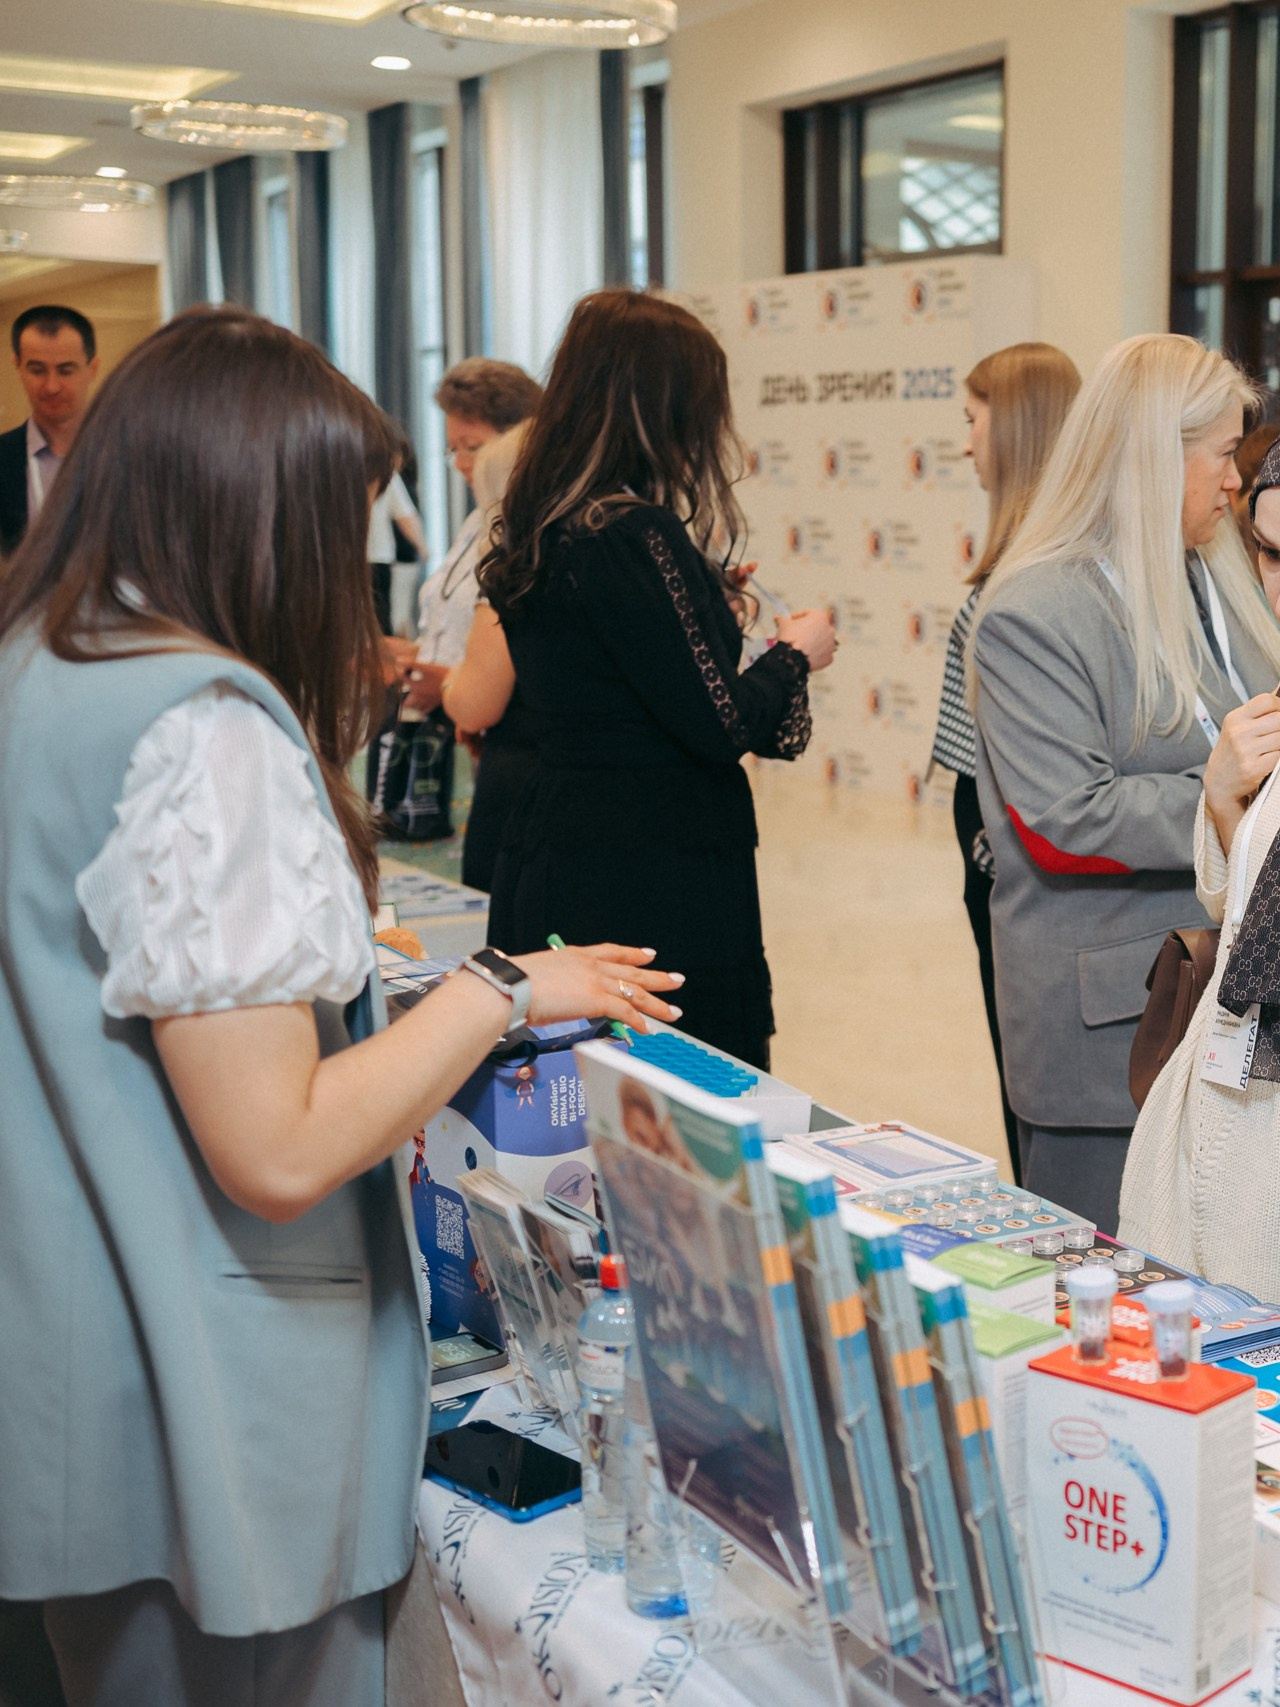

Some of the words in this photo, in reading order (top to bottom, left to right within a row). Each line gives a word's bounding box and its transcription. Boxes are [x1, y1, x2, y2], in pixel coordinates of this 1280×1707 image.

[760, 375, 808, 407] ДЕНЬ
[815, 370, 896, 403] ЗРЕНИЯ
[901, 367, 955, 400] 2025
[1239, 1014, 1258, 1089] ДЕЛЕГАТ
[559, 1075, 567, 1094] BIO
[568, 1076, 577, 1122] BI-FOCAL
[560, 1094, 568, 1127] PRIMA
[1064, 1480, 1128, 1525] ONE
[1064, 1514, 1145, 1558] STEP+
